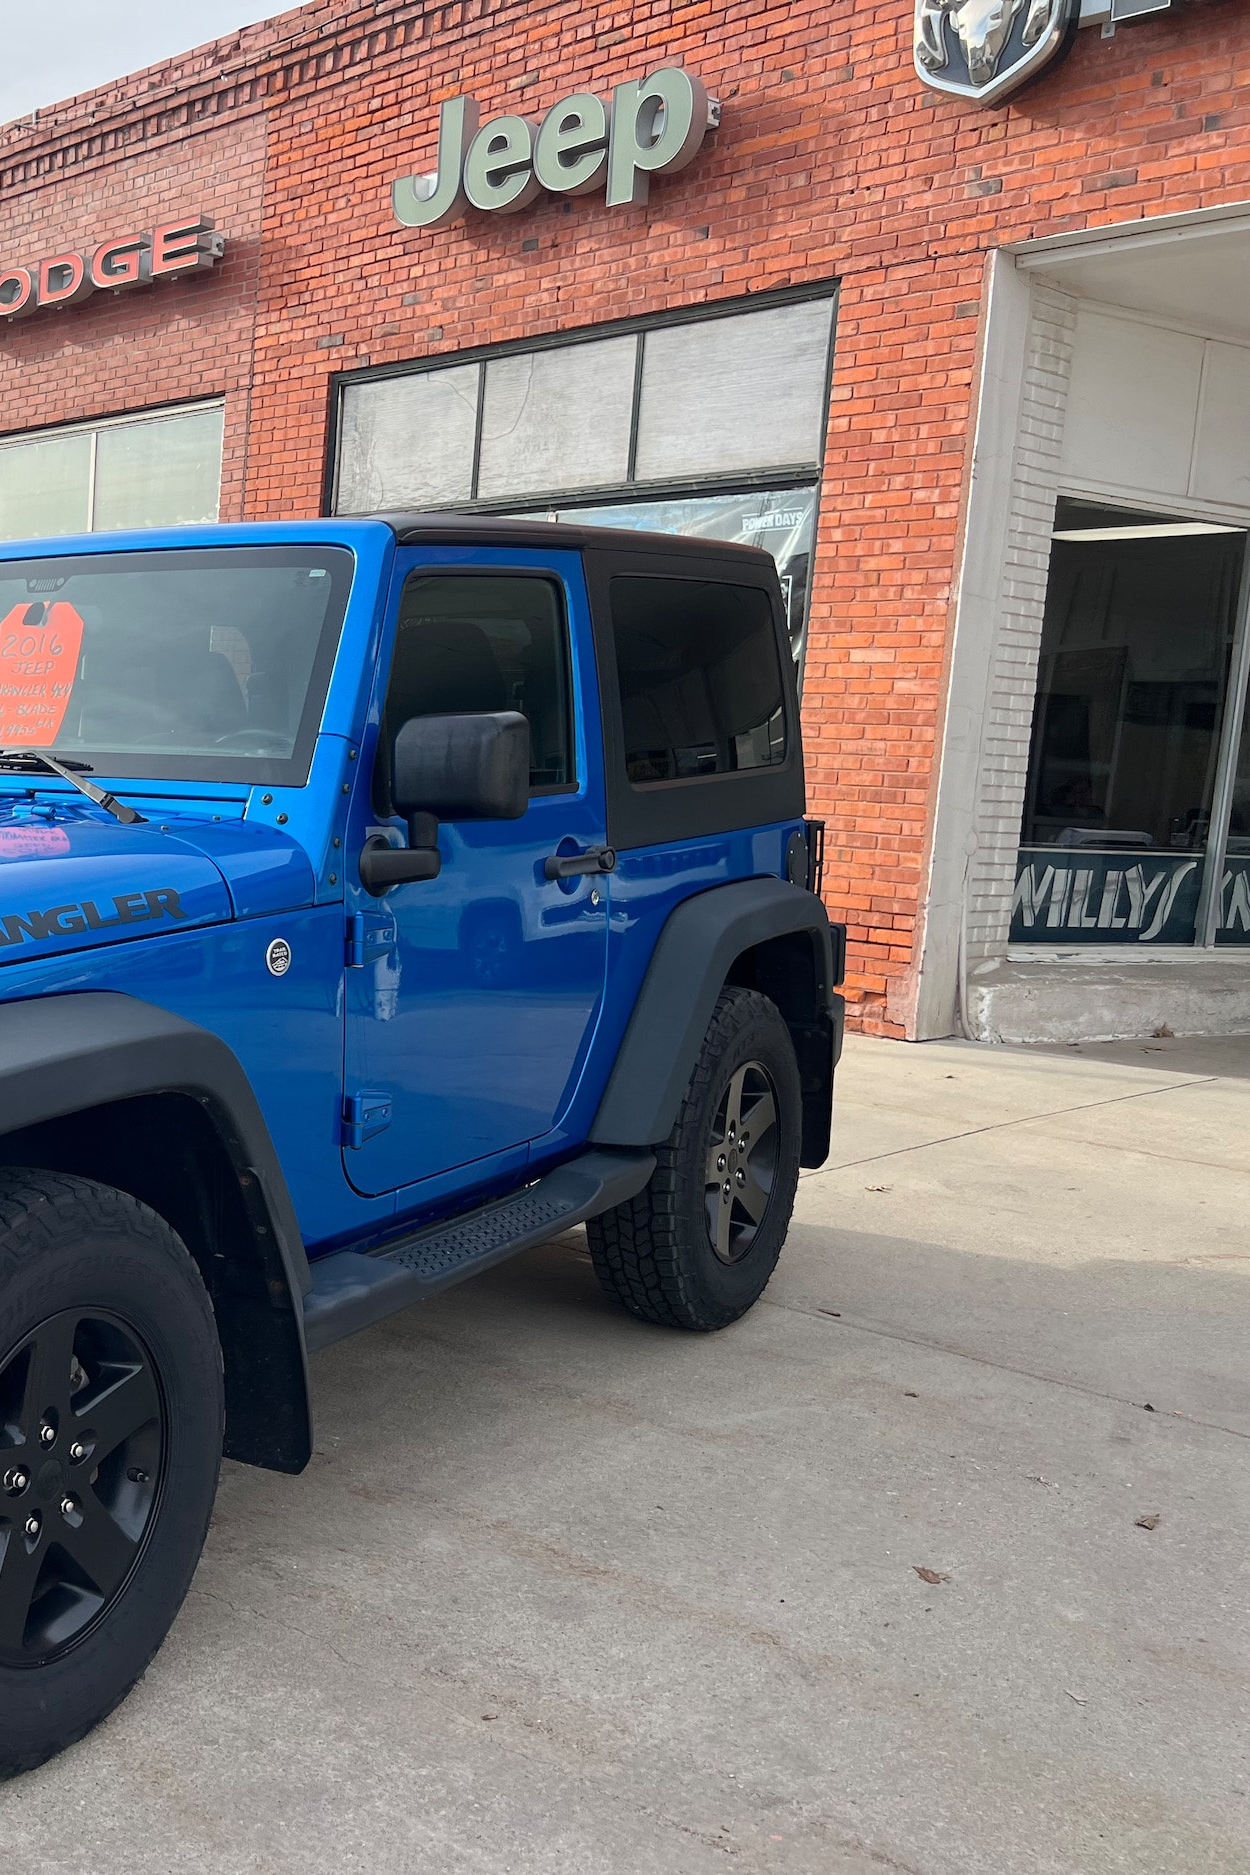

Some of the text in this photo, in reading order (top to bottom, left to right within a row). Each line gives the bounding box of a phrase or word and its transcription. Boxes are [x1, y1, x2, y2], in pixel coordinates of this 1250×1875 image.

[392, 66, 694, 228] Jeep
[742, 511, 803, 531] POWER DAYS
[1, 633, 63, 658] 2016
[11, 660, 54, 675] JEEP
[1012, 861, 1198, 941] WILLYS
